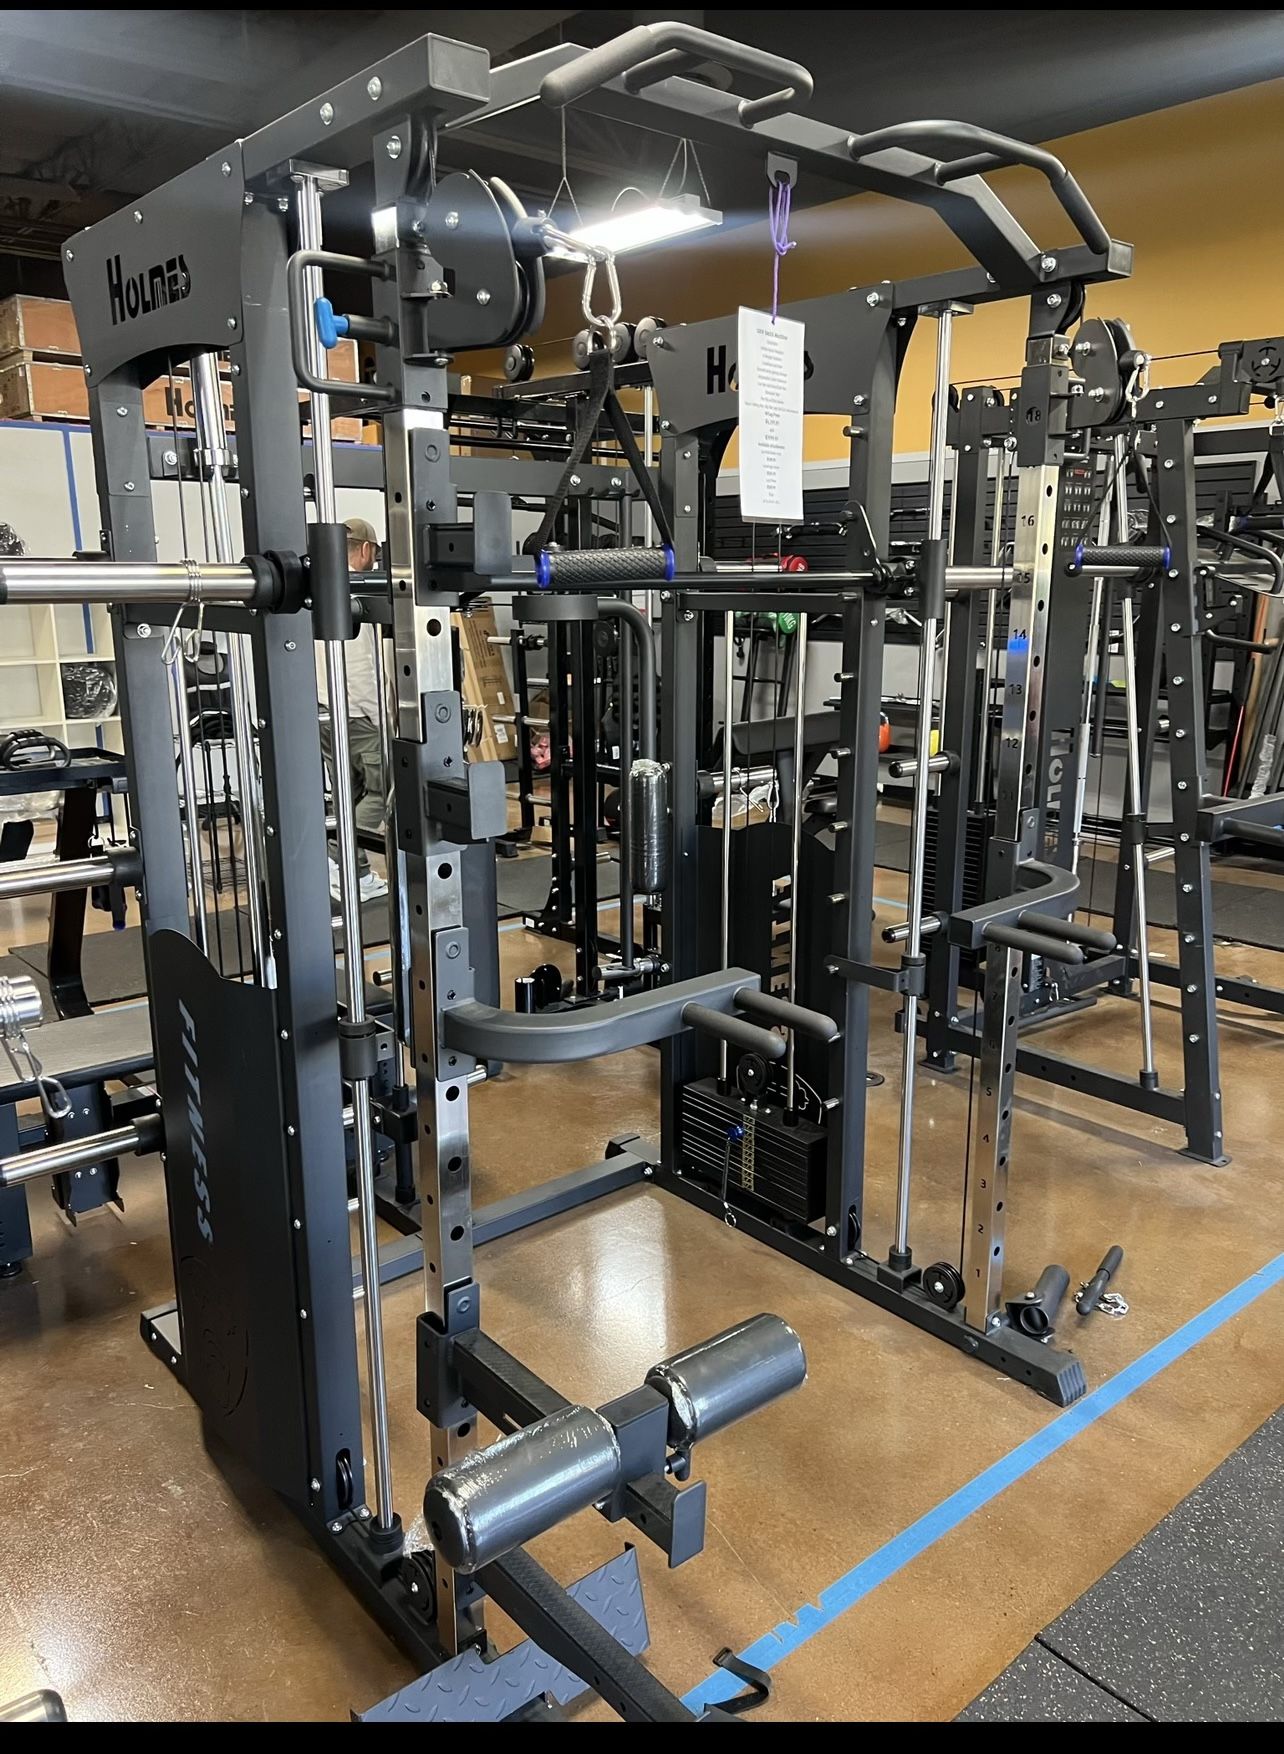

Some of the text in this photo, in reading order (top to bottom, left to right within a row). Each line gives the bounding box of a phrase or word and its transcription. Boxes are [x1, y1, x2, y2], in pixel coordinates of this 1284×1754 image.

[106, 254, 191, 325] HOLMES
[1021, 515, 1035, 527] 16
[1017, 572, 1030, 583] 15
[1013, 629, 1027, 640] 14
[1009, 684, 1022, 695] 13
[1005, 738, 1018, 749] 12
[985, 1087, 992, 1097] 5
[178, 999, 213, 1245] FITNESS
[980, 1179, 986, 1189] 3
[977, 1224, 984, 1234] 2
[975, 1268, 981, 1278] 1
